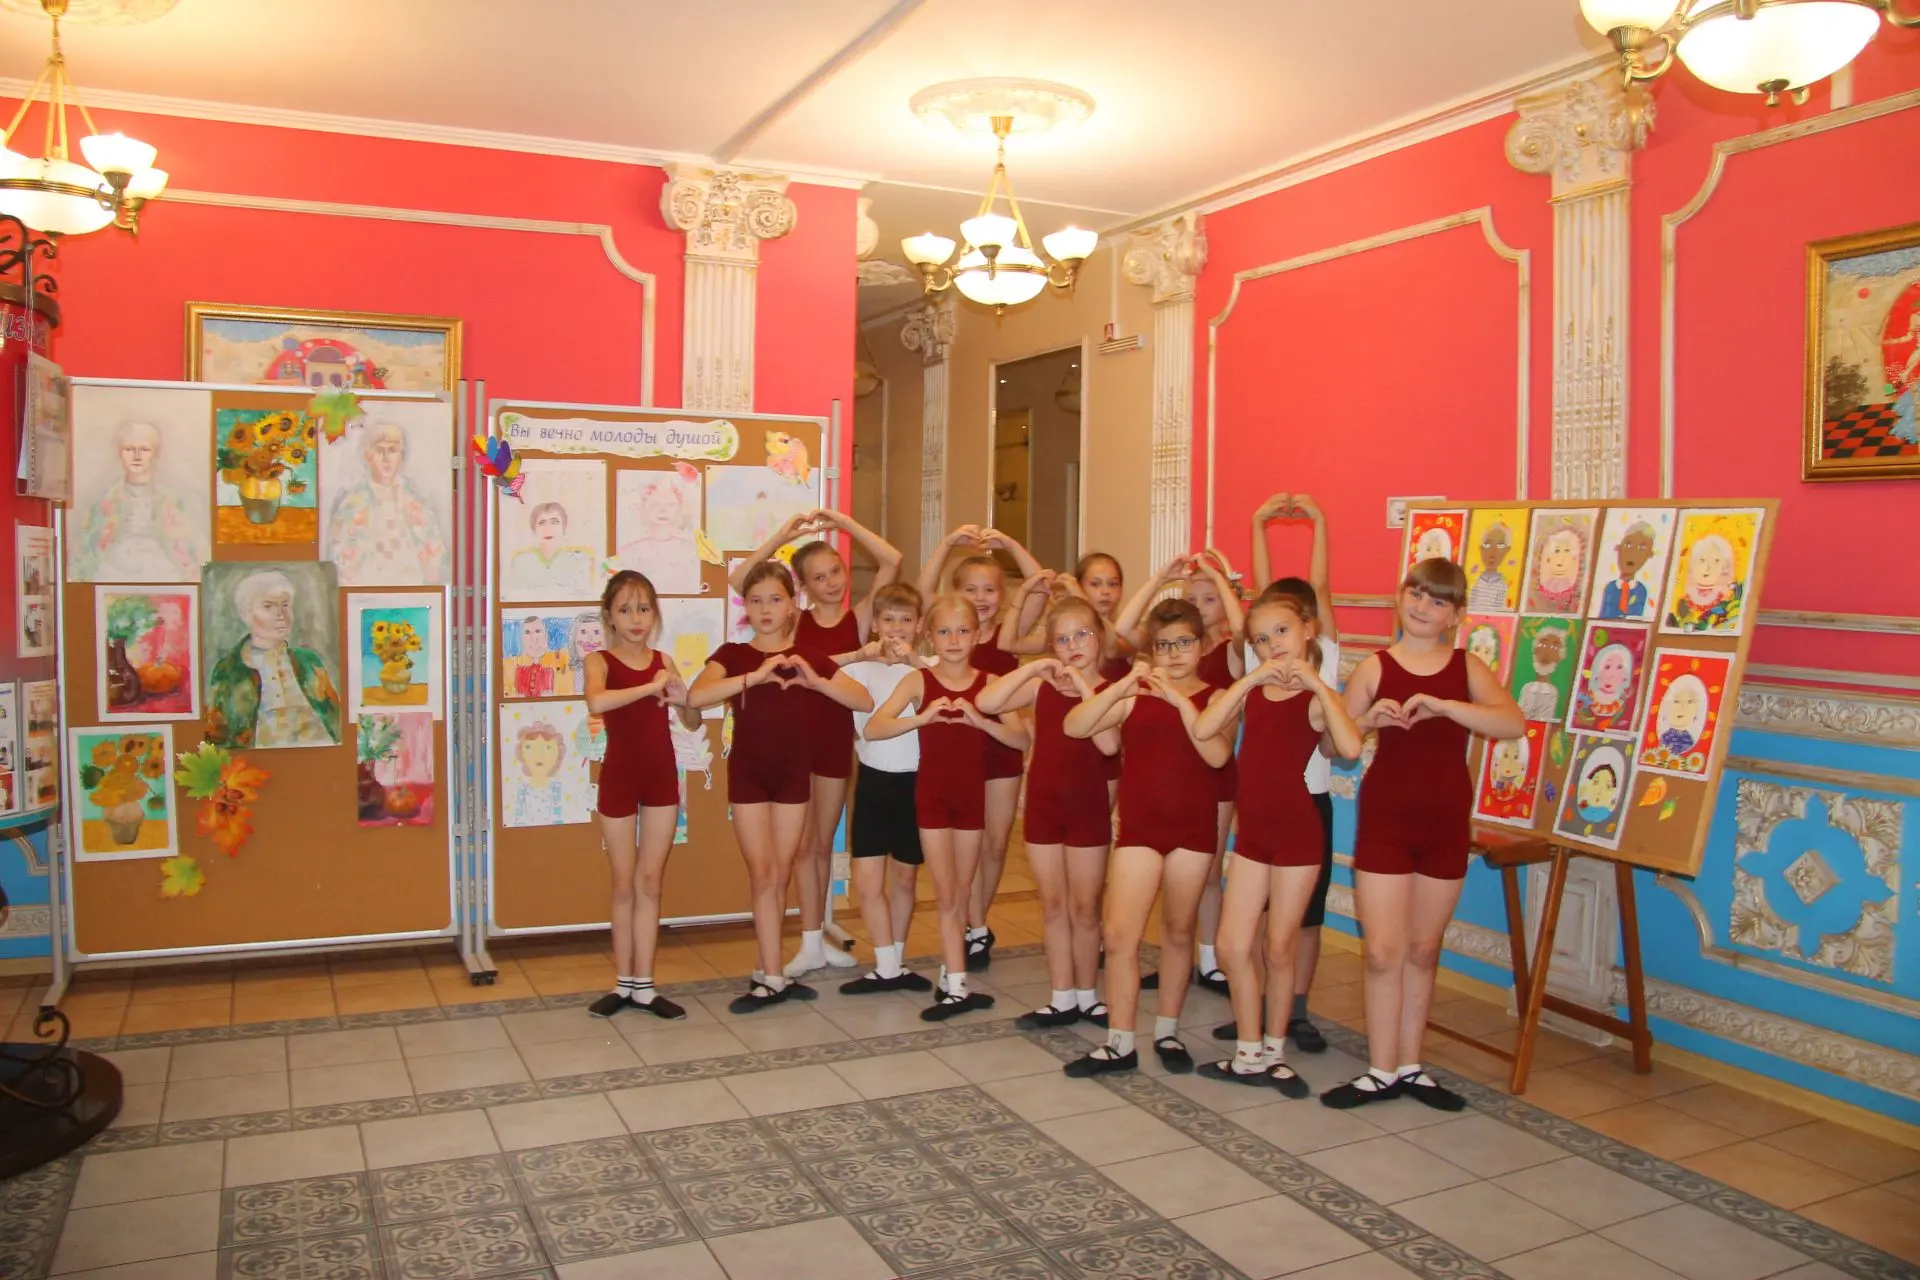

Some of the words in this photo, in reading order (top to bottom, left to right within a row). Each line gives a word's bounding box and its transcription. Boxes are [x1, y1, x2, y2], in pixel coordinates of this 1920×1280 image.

[510, 423, 531, 438] Вы
[540, 427, 583, 441] вечно
[590, 427, 658, 444] молоды
[665, 428, 721, 449] душой
